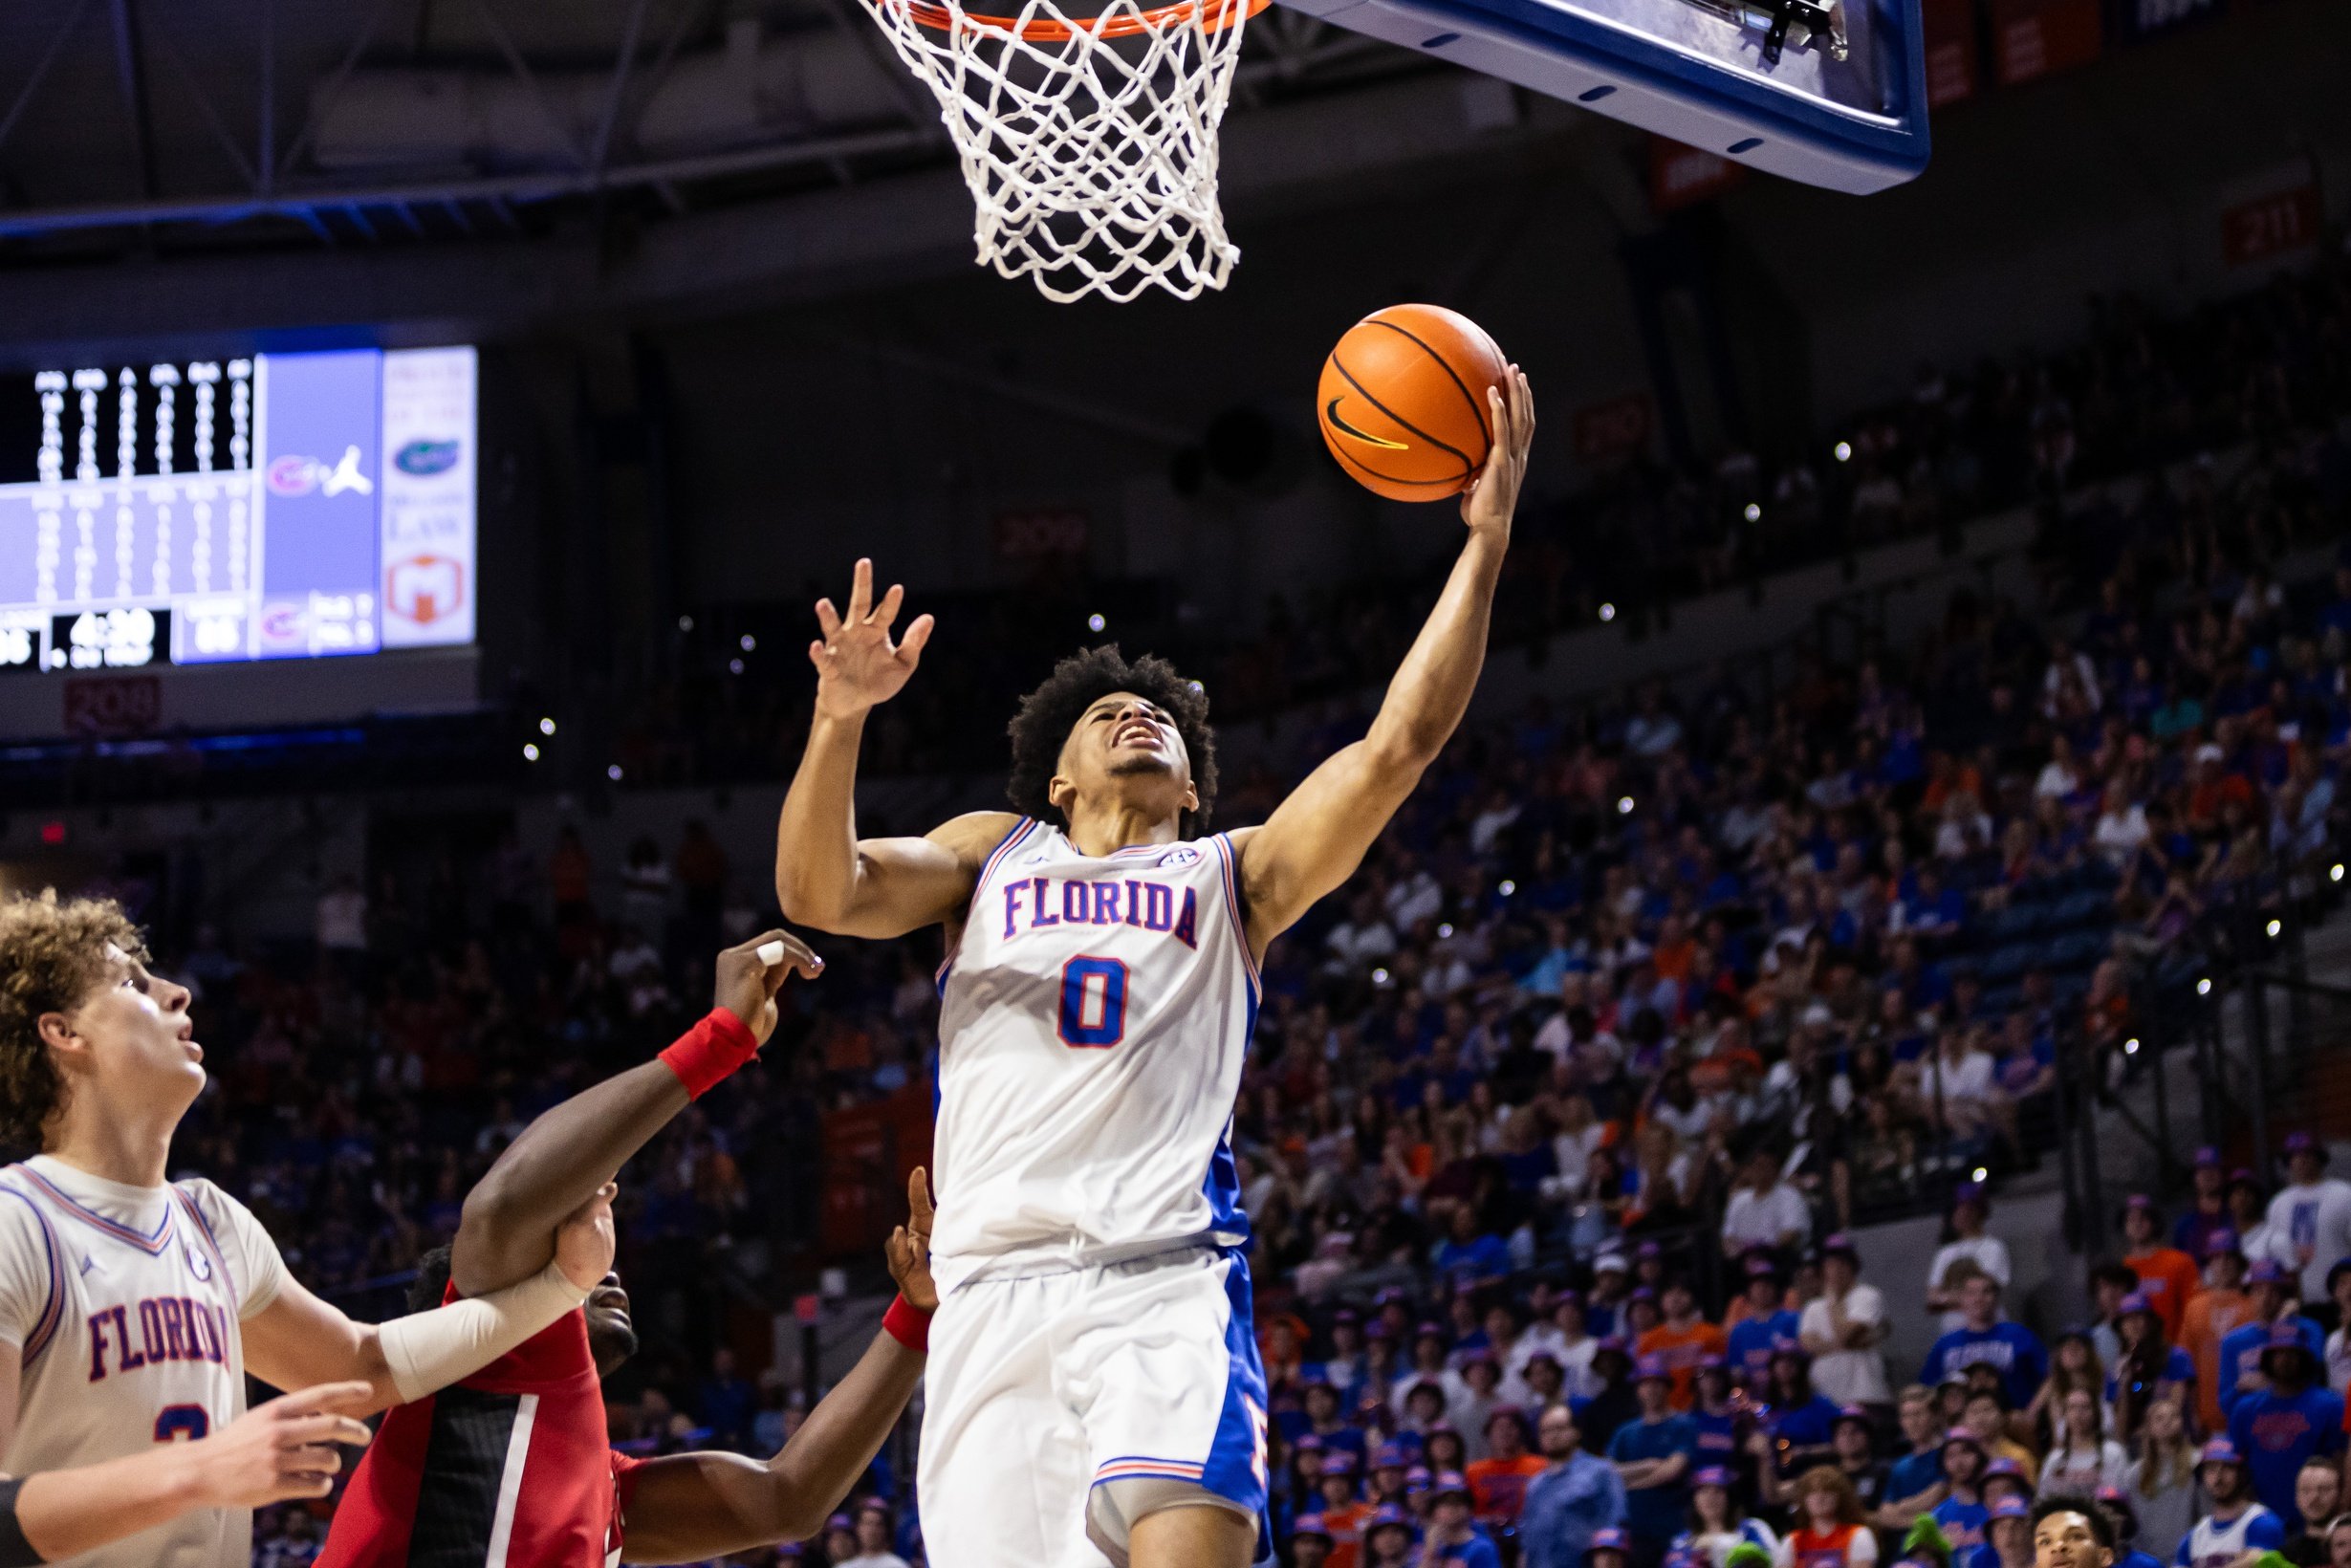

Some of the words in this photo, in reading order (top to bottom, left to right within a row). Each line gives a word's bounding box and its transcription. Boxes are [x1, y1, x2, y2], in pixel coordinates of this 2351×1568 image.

[2244, 201, 2297, 252] 211
[1003, 878, 1198, 950] FLORIDA
[1056, 954, 1130, 1049] 0
